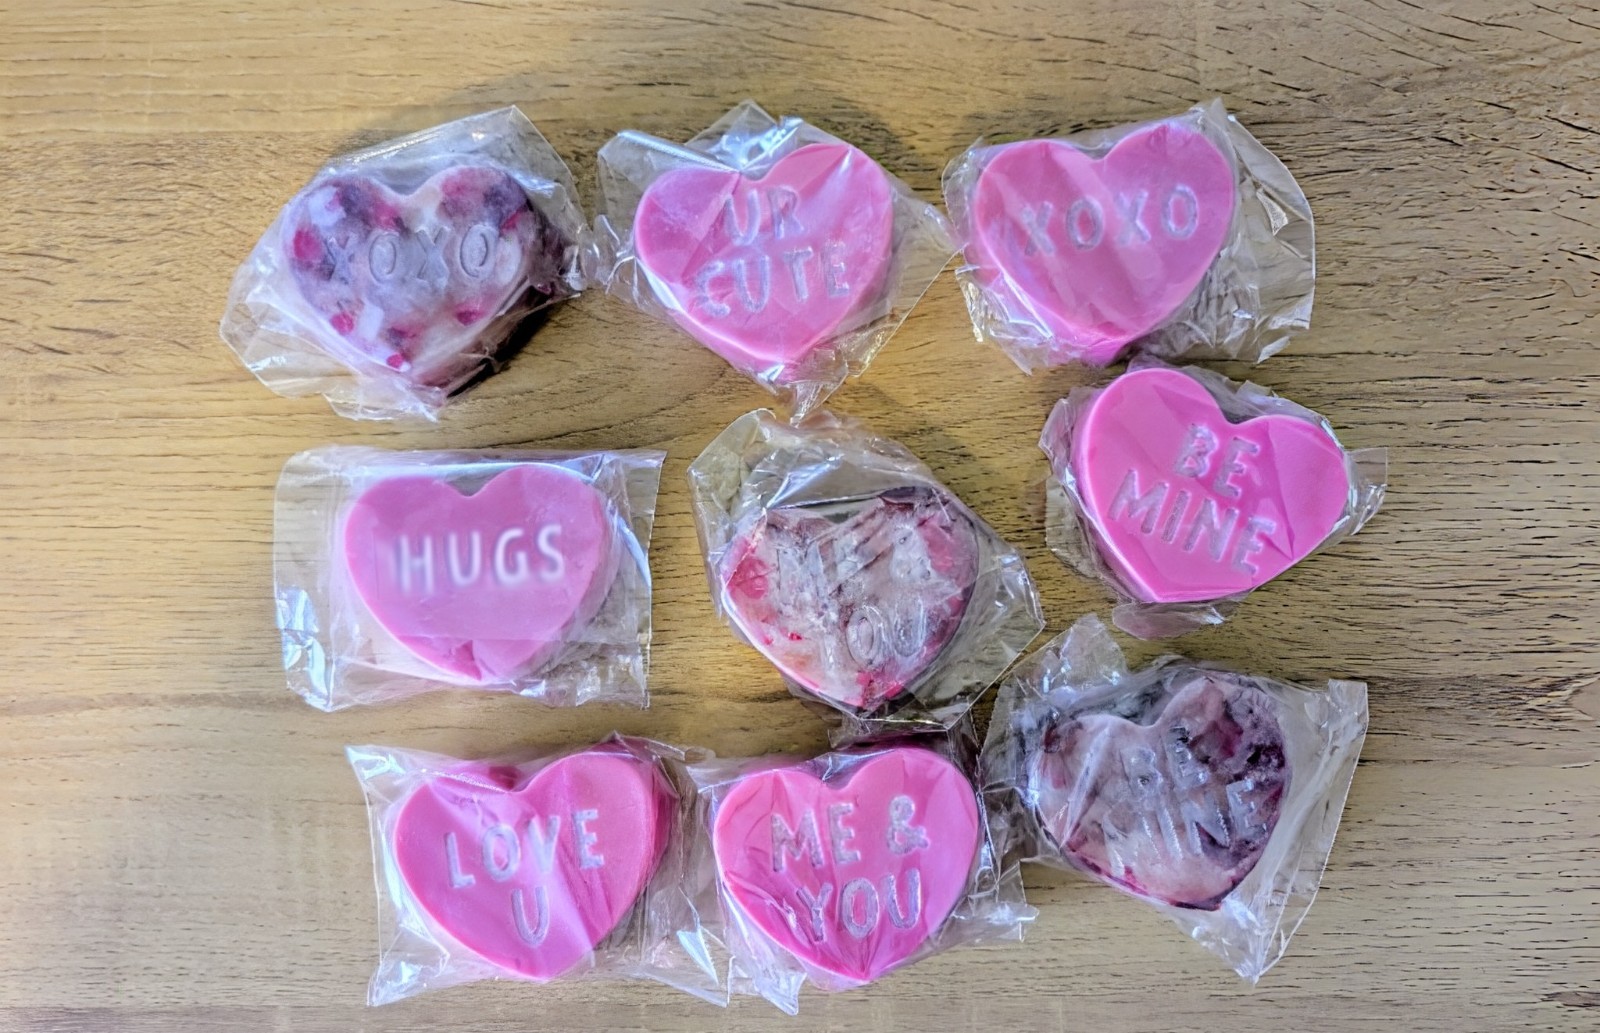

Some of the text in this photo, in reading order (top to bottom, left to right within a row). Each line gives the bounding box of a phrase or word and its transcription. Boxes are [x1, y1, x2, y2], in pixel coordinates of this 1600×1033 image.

[724, 187, 804, 246] UR
[1020, 183, 1199, 256] XOXO
[696, 242, 850, 317] CUTE
[1175, 422, 1260, 498] BE
[398, 523, 565, 596] HUGS
[1107, 469, 1276, 576] MINE
[444, 808, 604, 889] LOVE
[770, 795, 930, 873] ME &
[511, 886, 550, 946] U
[797, 868, 922, 944] YOU
